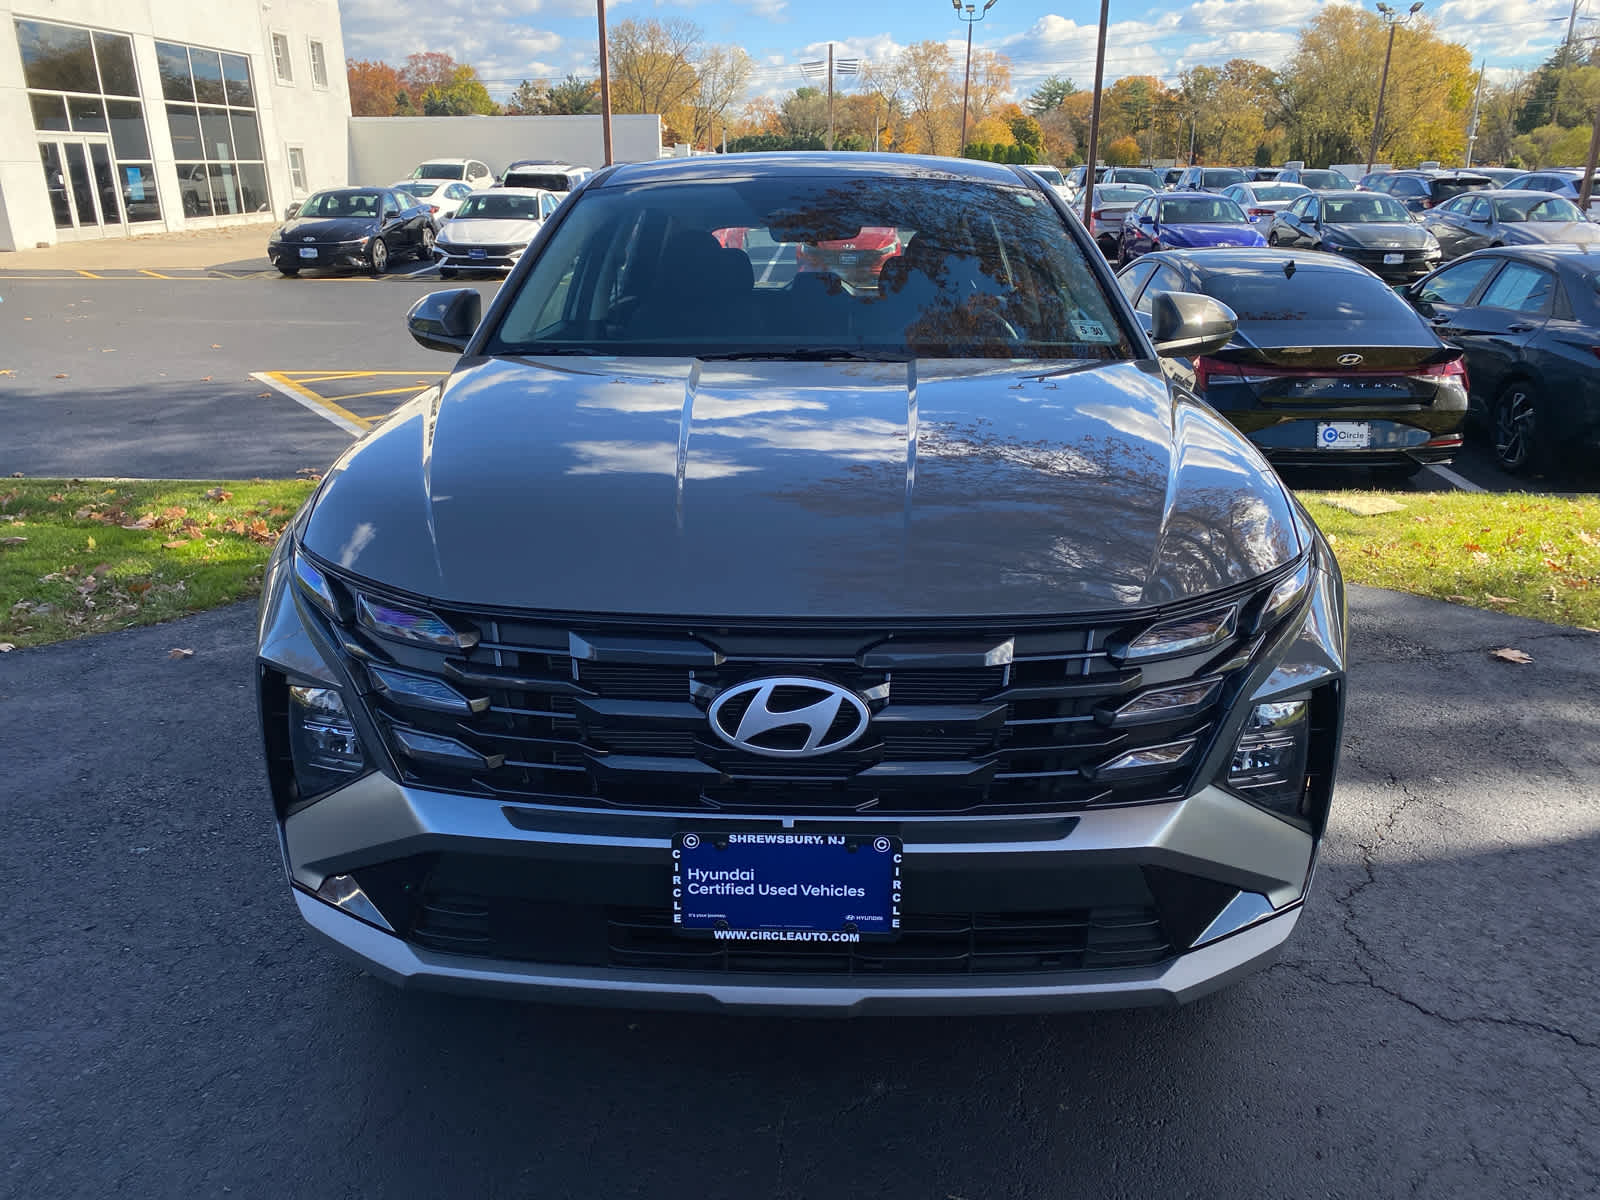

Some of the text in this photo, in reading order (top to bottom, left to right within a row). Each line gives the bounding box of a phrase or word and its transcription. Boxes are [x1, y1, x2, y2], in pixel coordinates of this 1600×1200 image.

[1080, 326, 1088, 334] 5
[1338, 431, 1365, 440] Circle
[827, 836, 846, 845] NJ
[687, 868, 755, 883] Hyundai
[672, 849, 682, 924] CIRCLE
[687, 883, 866, 897] Certified Used Vehicles
[892, 854, 902, 928] CIRCLE
[713, 930, 860, 942] WWW.CIRCLEAUTO.COM
